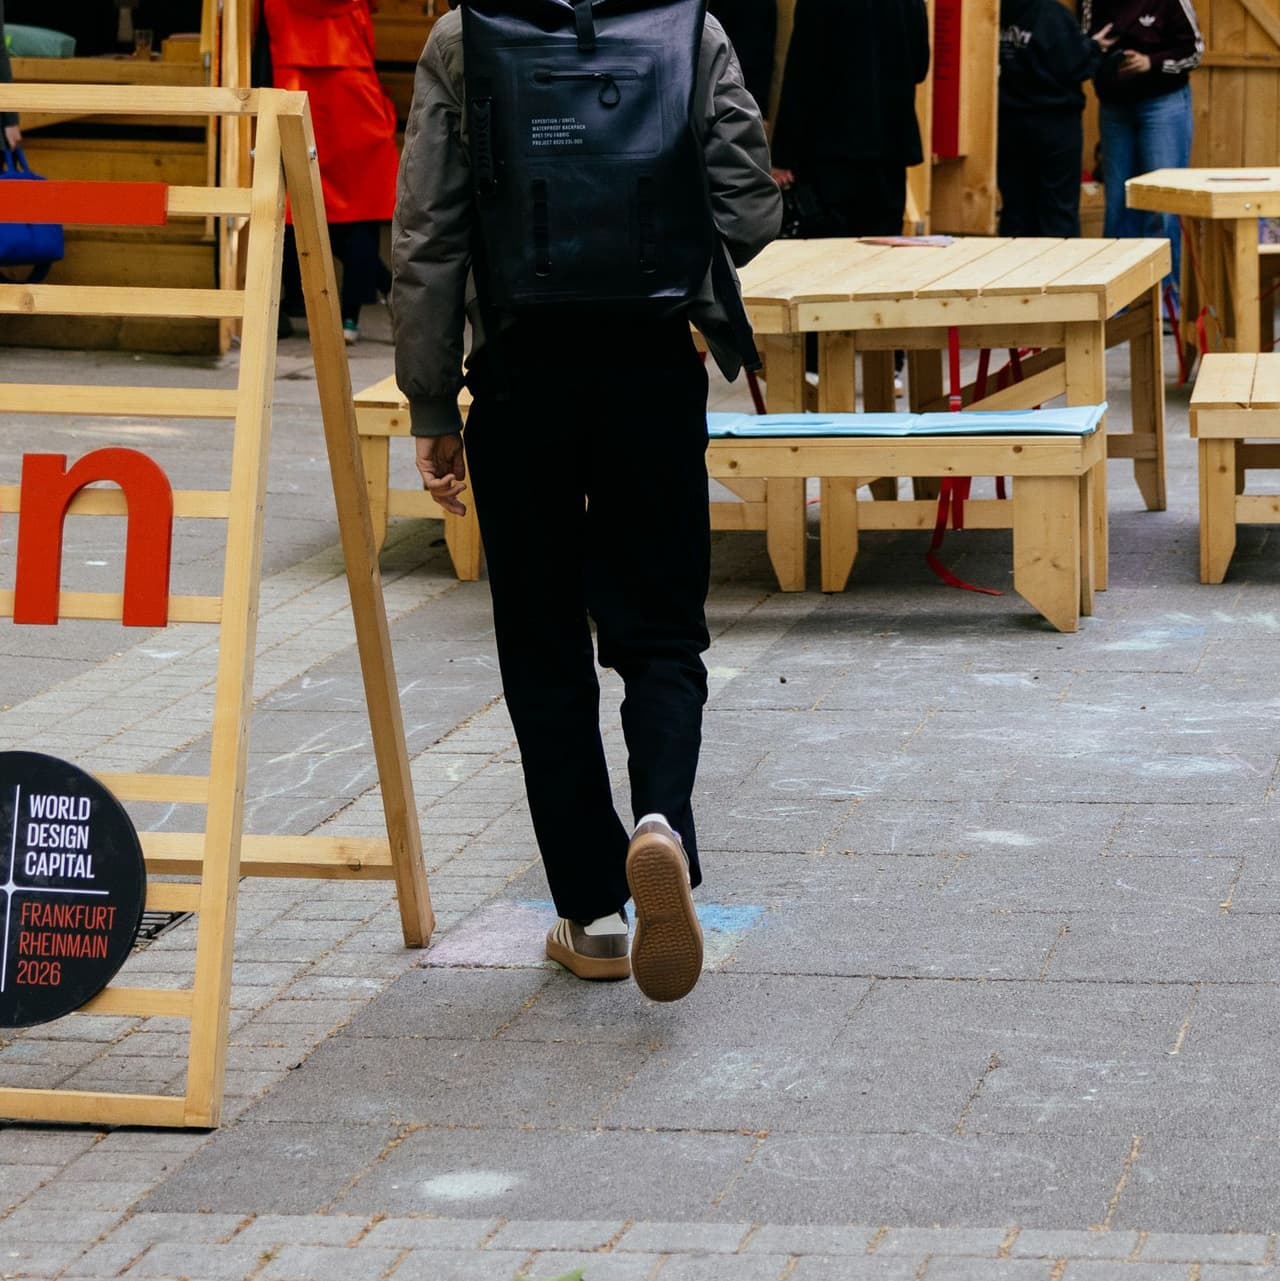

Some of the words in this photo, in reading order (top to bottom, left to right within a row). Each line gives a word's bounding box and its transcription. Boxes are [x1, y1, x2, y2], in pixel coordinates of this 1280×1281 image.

[28, 794, 91, 821] WORLD
[26, 823, 90, 850] DESIGN
[24, 851, 96, 879] CAPITAL
[19, 902, 117, 930] FRANKFURT
[18, 933, 109, 959] RHEINMAIN
[16, 960, 62, 987] 2026
